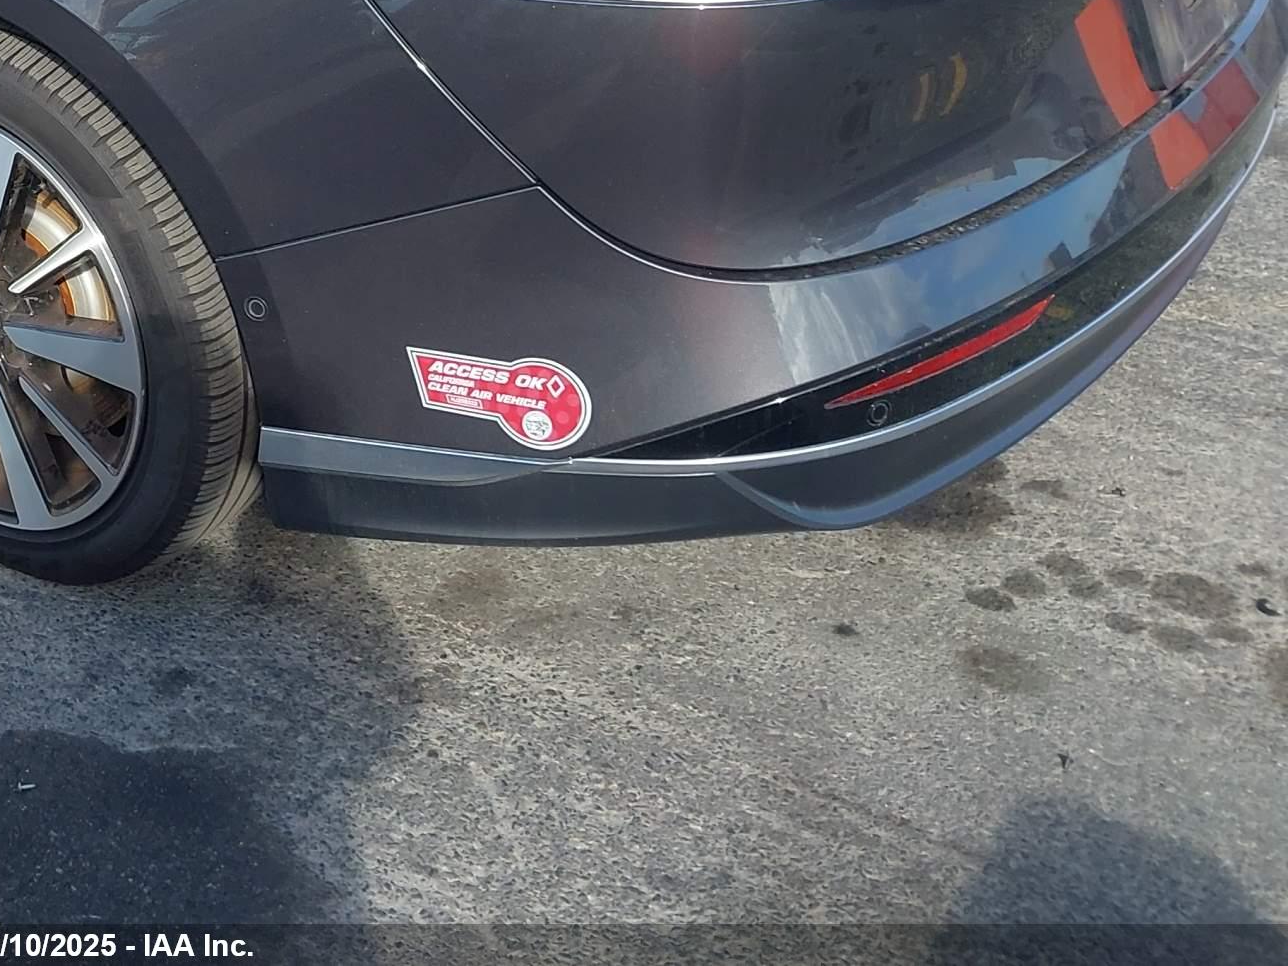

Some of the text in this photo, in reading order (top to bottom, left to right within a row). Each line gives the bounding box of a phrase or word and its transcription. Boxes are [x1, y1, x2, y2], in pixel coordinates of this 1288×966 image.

[427, 373, 475, 388] CALIFORNIA
[428, 360, 547, 391] ACCESS OK
[427, 381, 470, 397] CLEAN
[470, 390, 494, 401] AIR
[496, 393, 547, 410] VEHICLE
